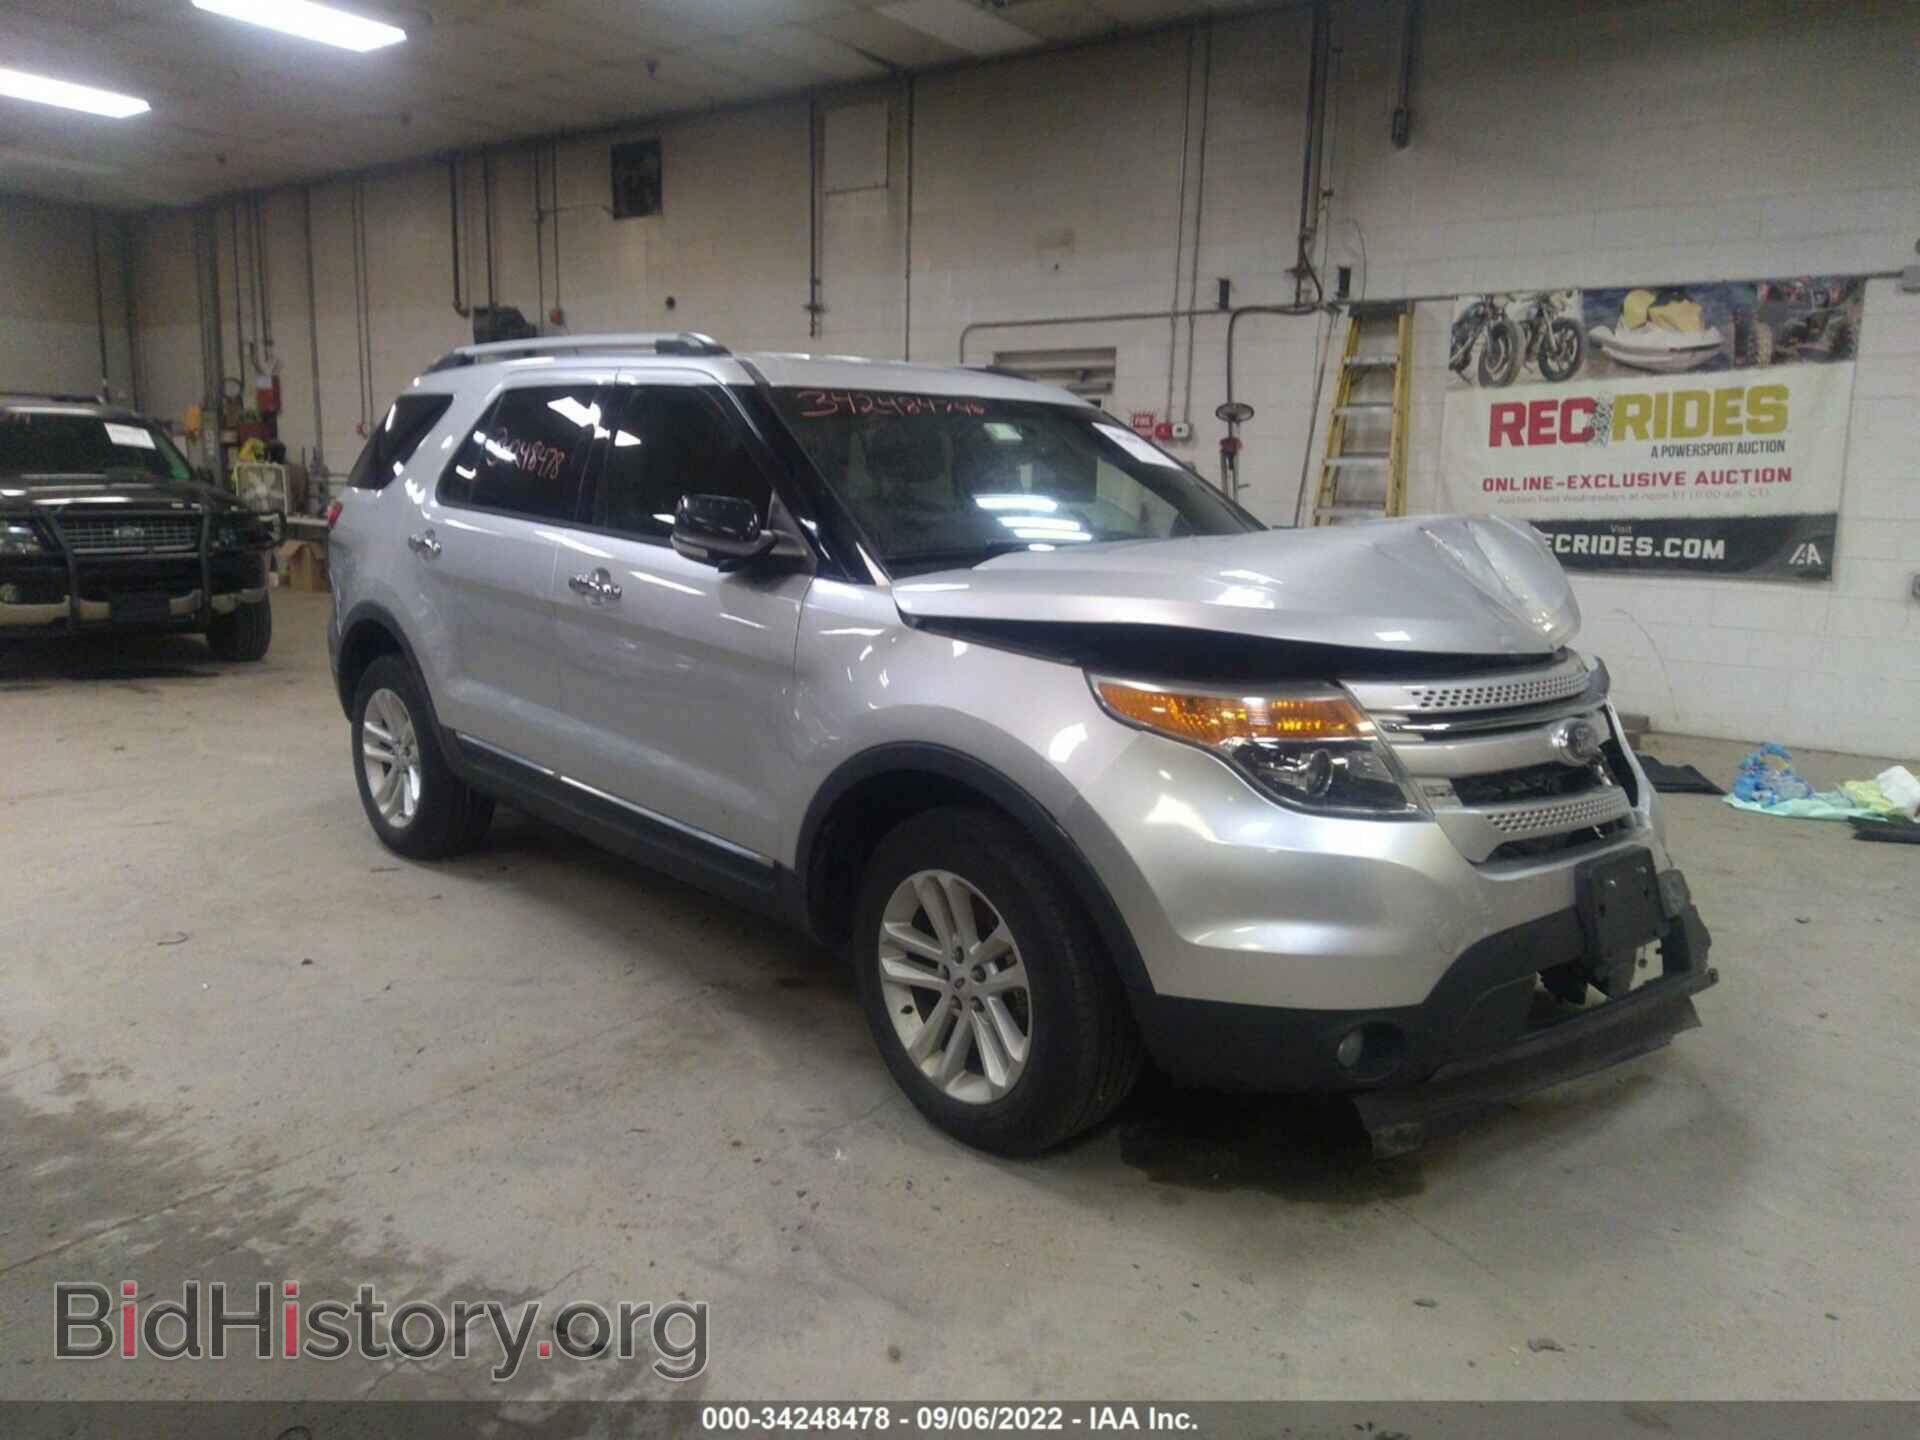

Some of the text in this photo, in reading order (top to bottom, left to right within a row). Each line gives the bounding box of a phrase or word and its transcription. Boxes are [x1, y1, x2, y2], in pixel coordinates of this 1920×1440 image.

[1488, 384, 1790, 447] REC RIDES
[1651, 440, 1785, 458] A POWERSPORT AUCTION
[1482, 467, 1792, 492] ONLINE-EXCLUSIVE AUCTION
[1611, 524, 1632, 534] Visit
[1544, 534, 1725, 560] ECRIDES.COM
